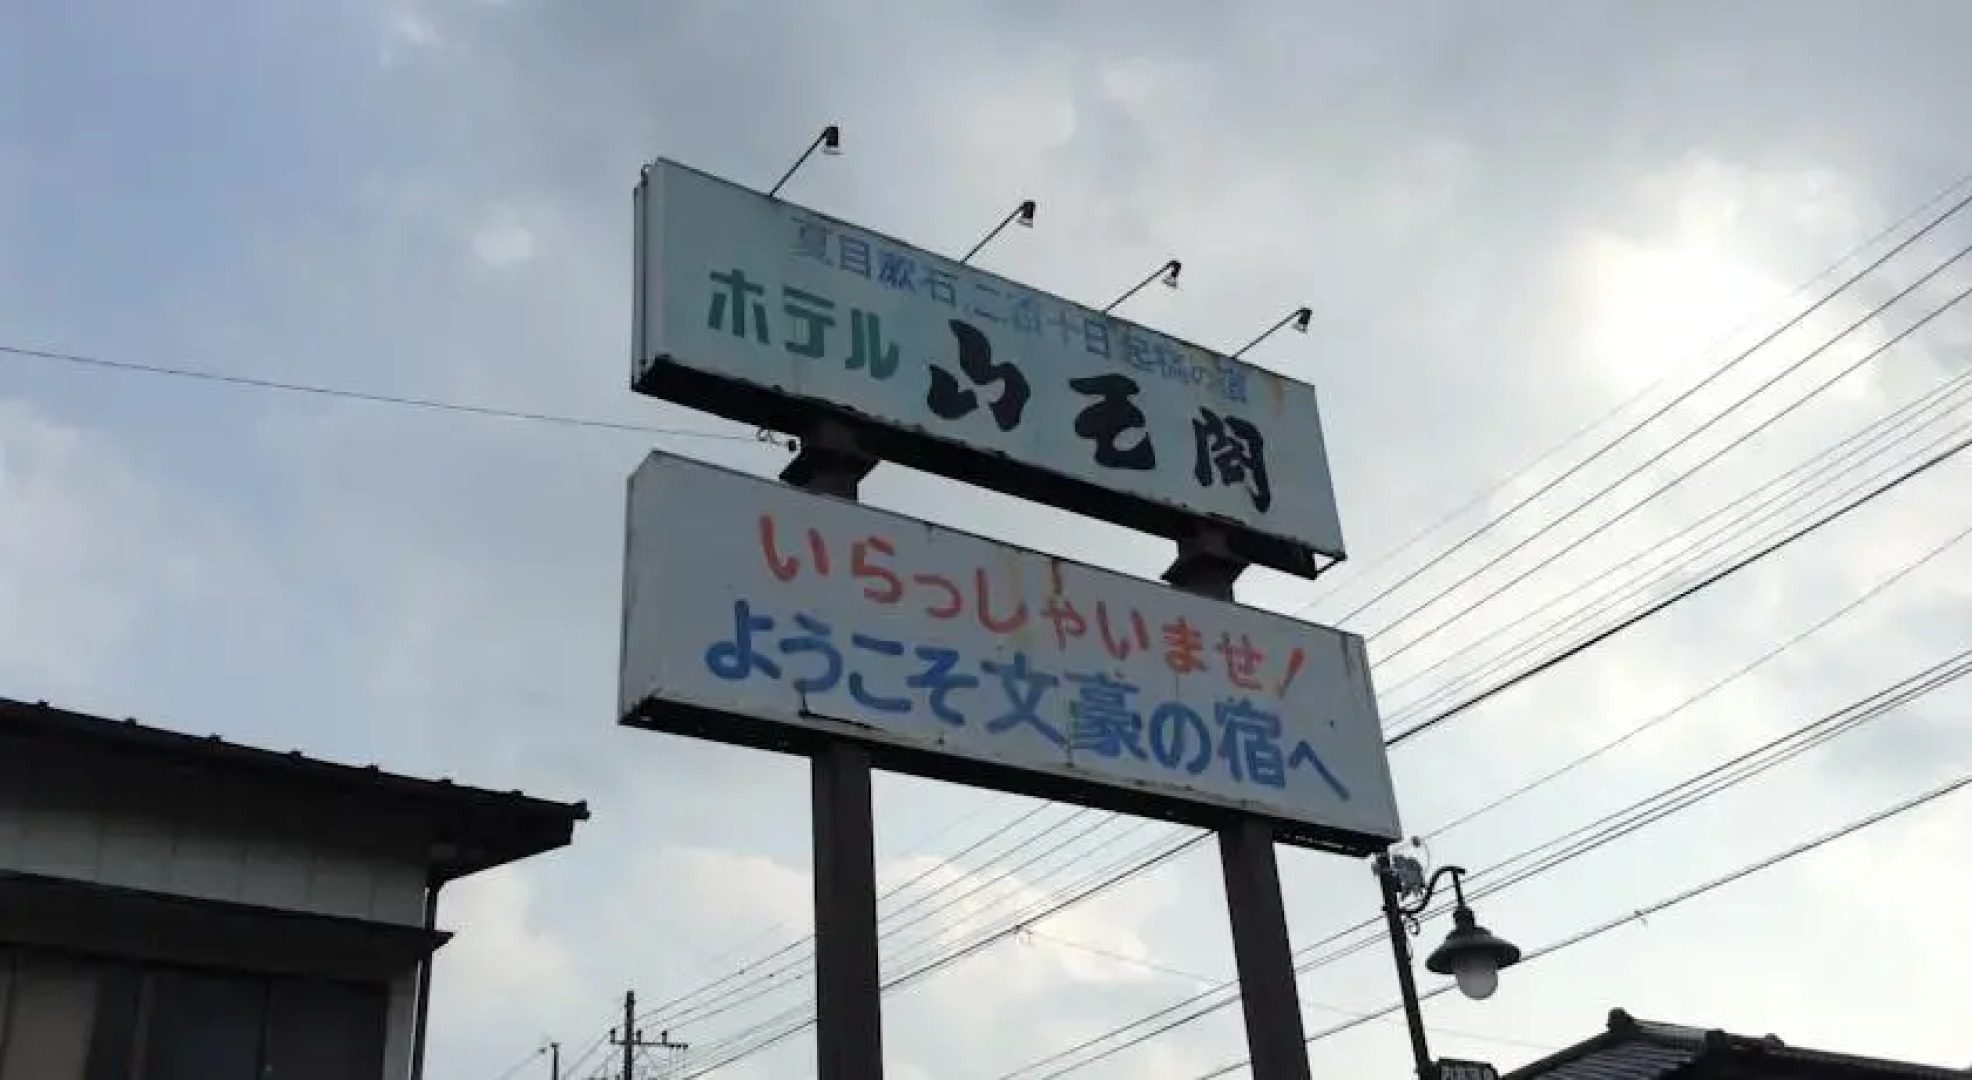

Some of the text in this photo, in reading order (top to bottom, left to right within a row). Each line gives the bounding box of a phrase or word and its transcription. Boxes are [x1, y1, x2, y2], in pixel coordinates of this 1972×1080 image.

[708, 269, 1271, 512] ホテル 山王閣
[704, 599, 1351, 801] ようこそ文豪の宿へ
